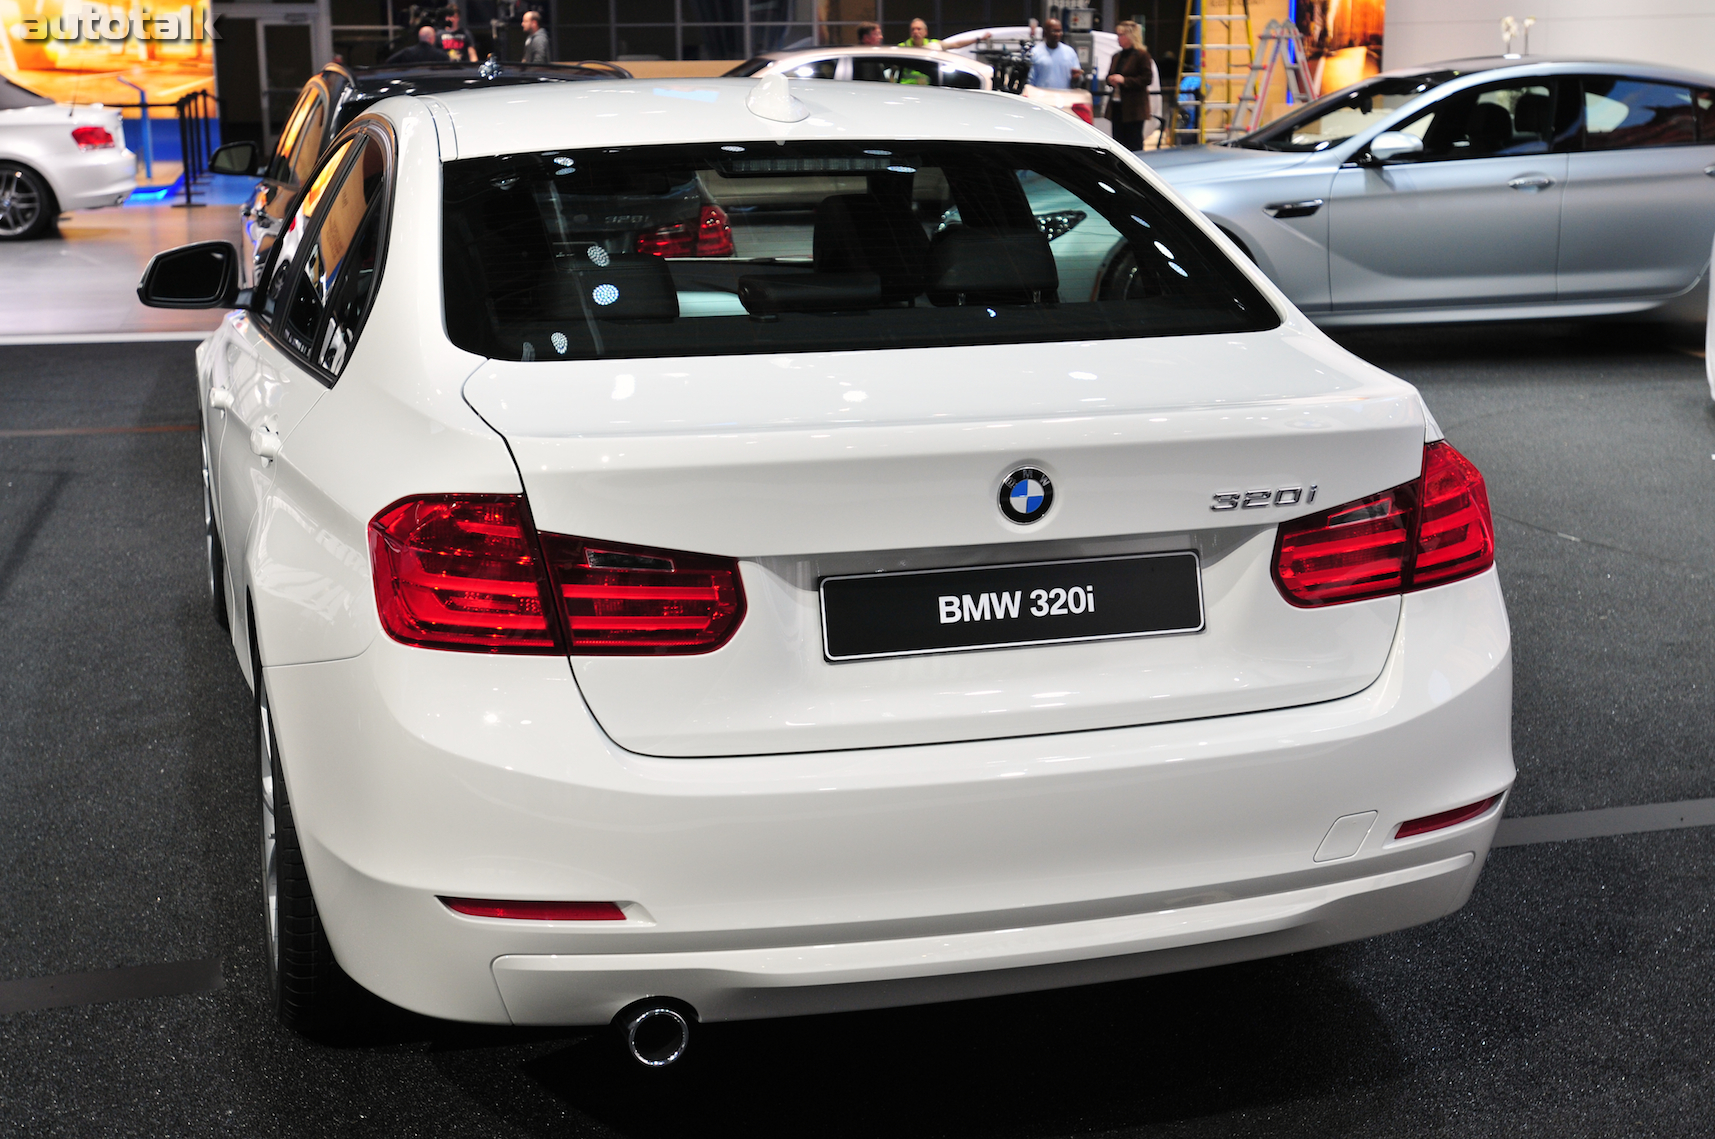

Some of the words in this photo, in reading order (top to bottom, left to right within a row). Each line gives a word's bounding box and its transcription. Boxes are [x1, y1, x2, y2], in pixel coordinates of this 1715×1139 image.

[1004, 469, 1051, 489] BMW
[1210, 484, 1318, 512] 320i
[938, 590, 1022, 624] BMW
[1029, 585, 1095, 617] 320i
